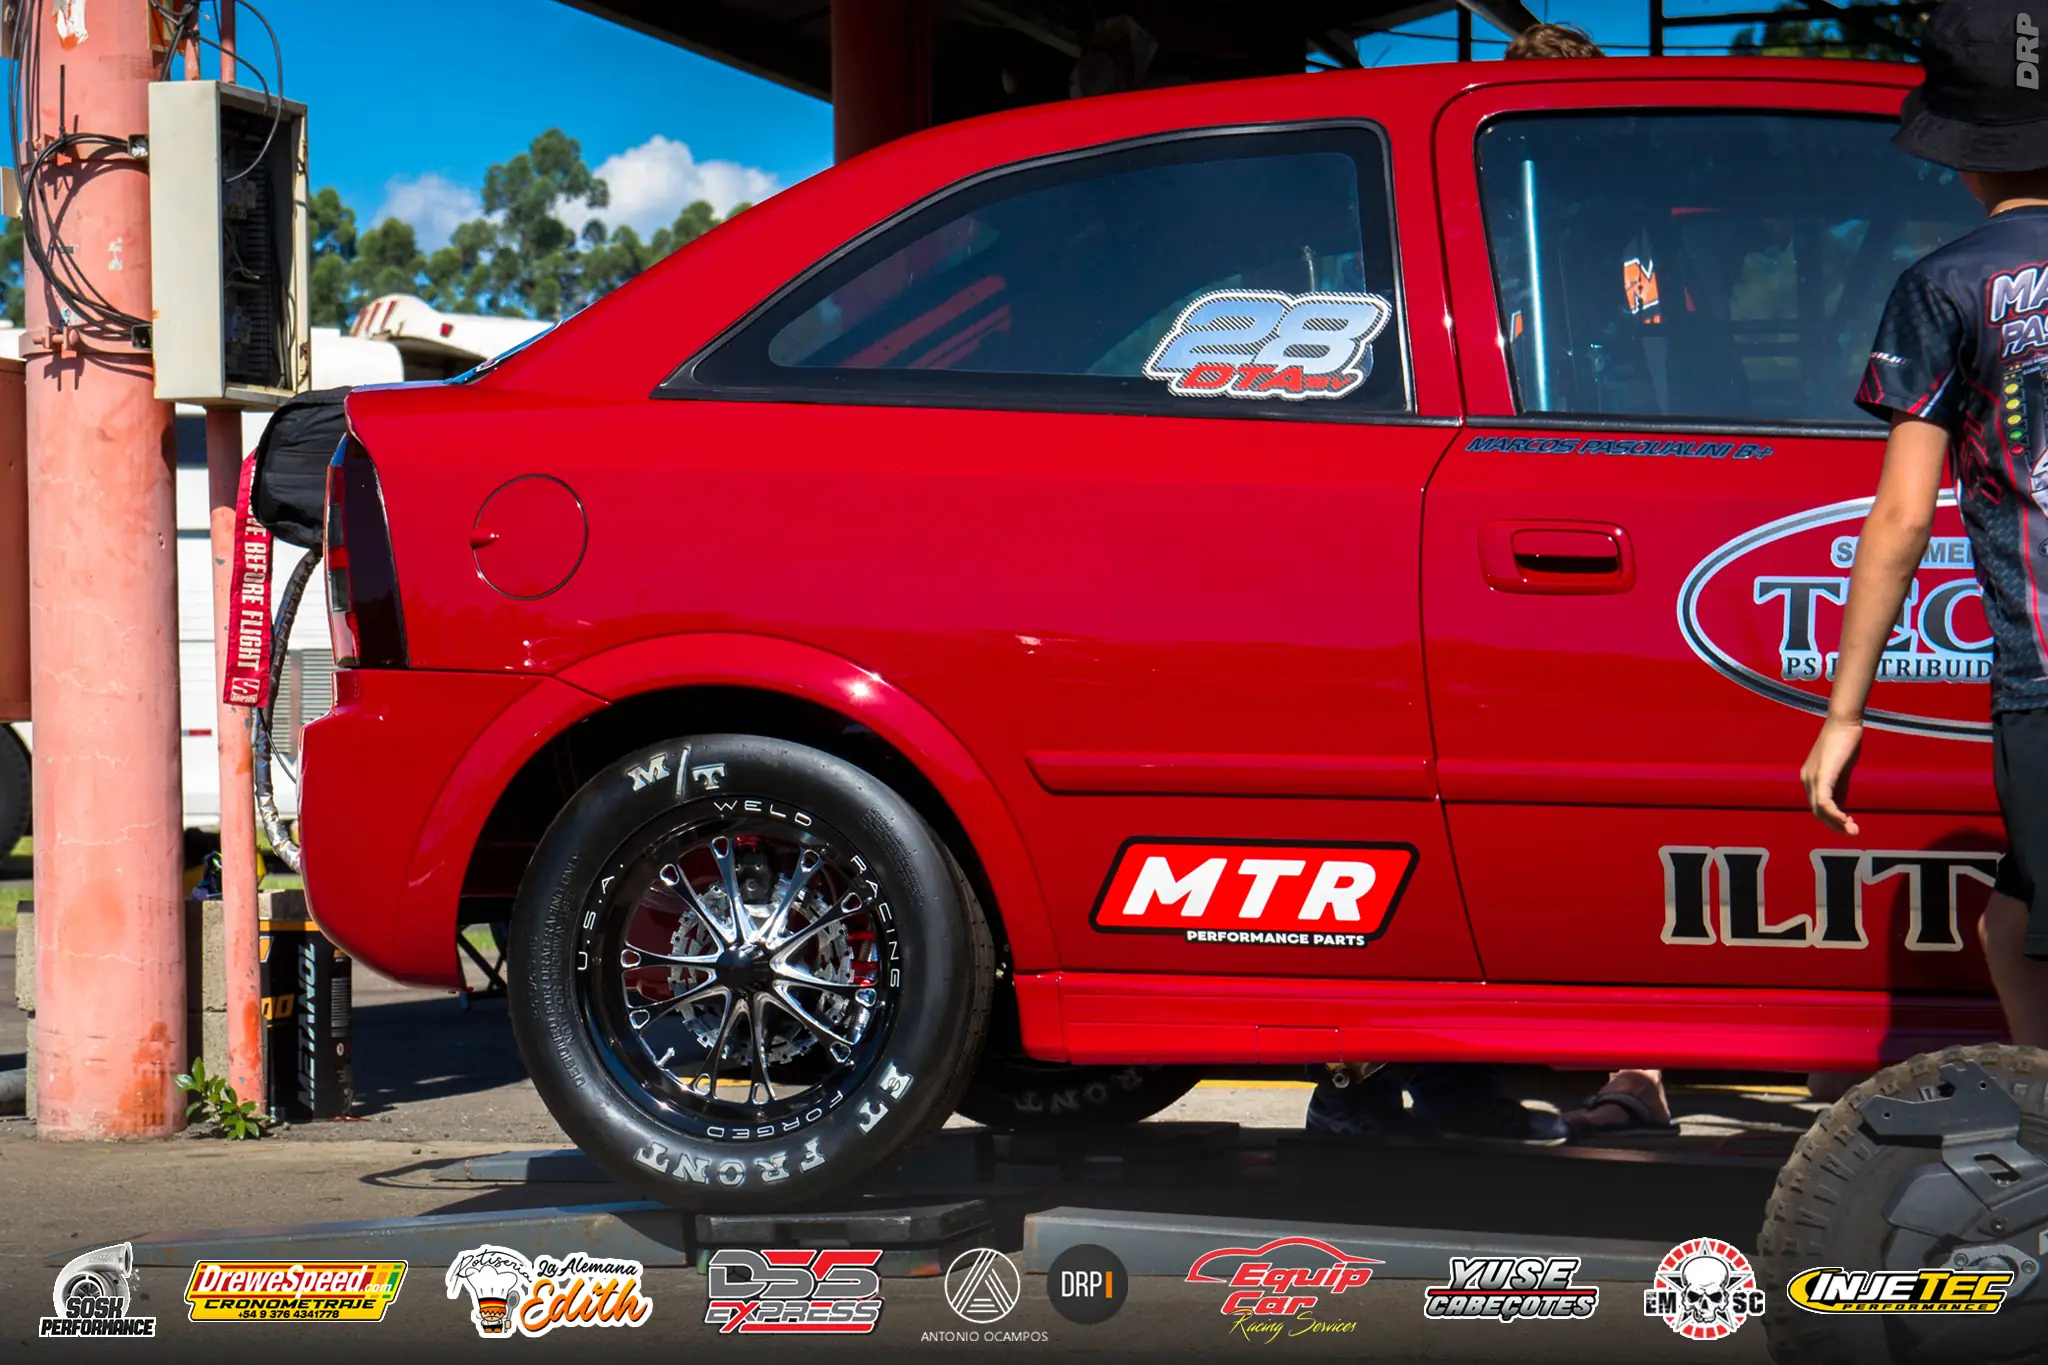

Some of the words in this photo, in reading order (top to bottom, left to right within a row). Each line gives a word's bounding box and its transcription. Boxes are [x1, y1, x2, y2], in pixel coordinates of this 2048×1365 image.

[1151, 301, 1384, 373] 28
[1181, 364, 1303, 391] DTA
[1464, 436, 1580, 454] MARCOS
[1576, 438, 1736, 459] PASQUALINI
[1731, 443, 1775, 460] B+
[241, 540, 267, 606] BEFORE
[236, 608, 264, 672] FLIGHT
[1785, 655, 1818, 678] PS
[627, 745, 727, 796] M/T
[713, 799, 813, 828] WELD
[1122, 856, 1377, 922] MTR
[849, 854, 902, 989] RACING
[1186, 930, 1310, 945] PERFORMANCE
[1313, 935, 1365, 947] PARTS
[540, 941, 555, 981] DRAG
[540, 984, 556, 1016] FOR
[297, 942, 316, 1111] METANOL
[706, 1090, 844, 1140] FORGED
[633, 1139, 827, 1188] FRONT
